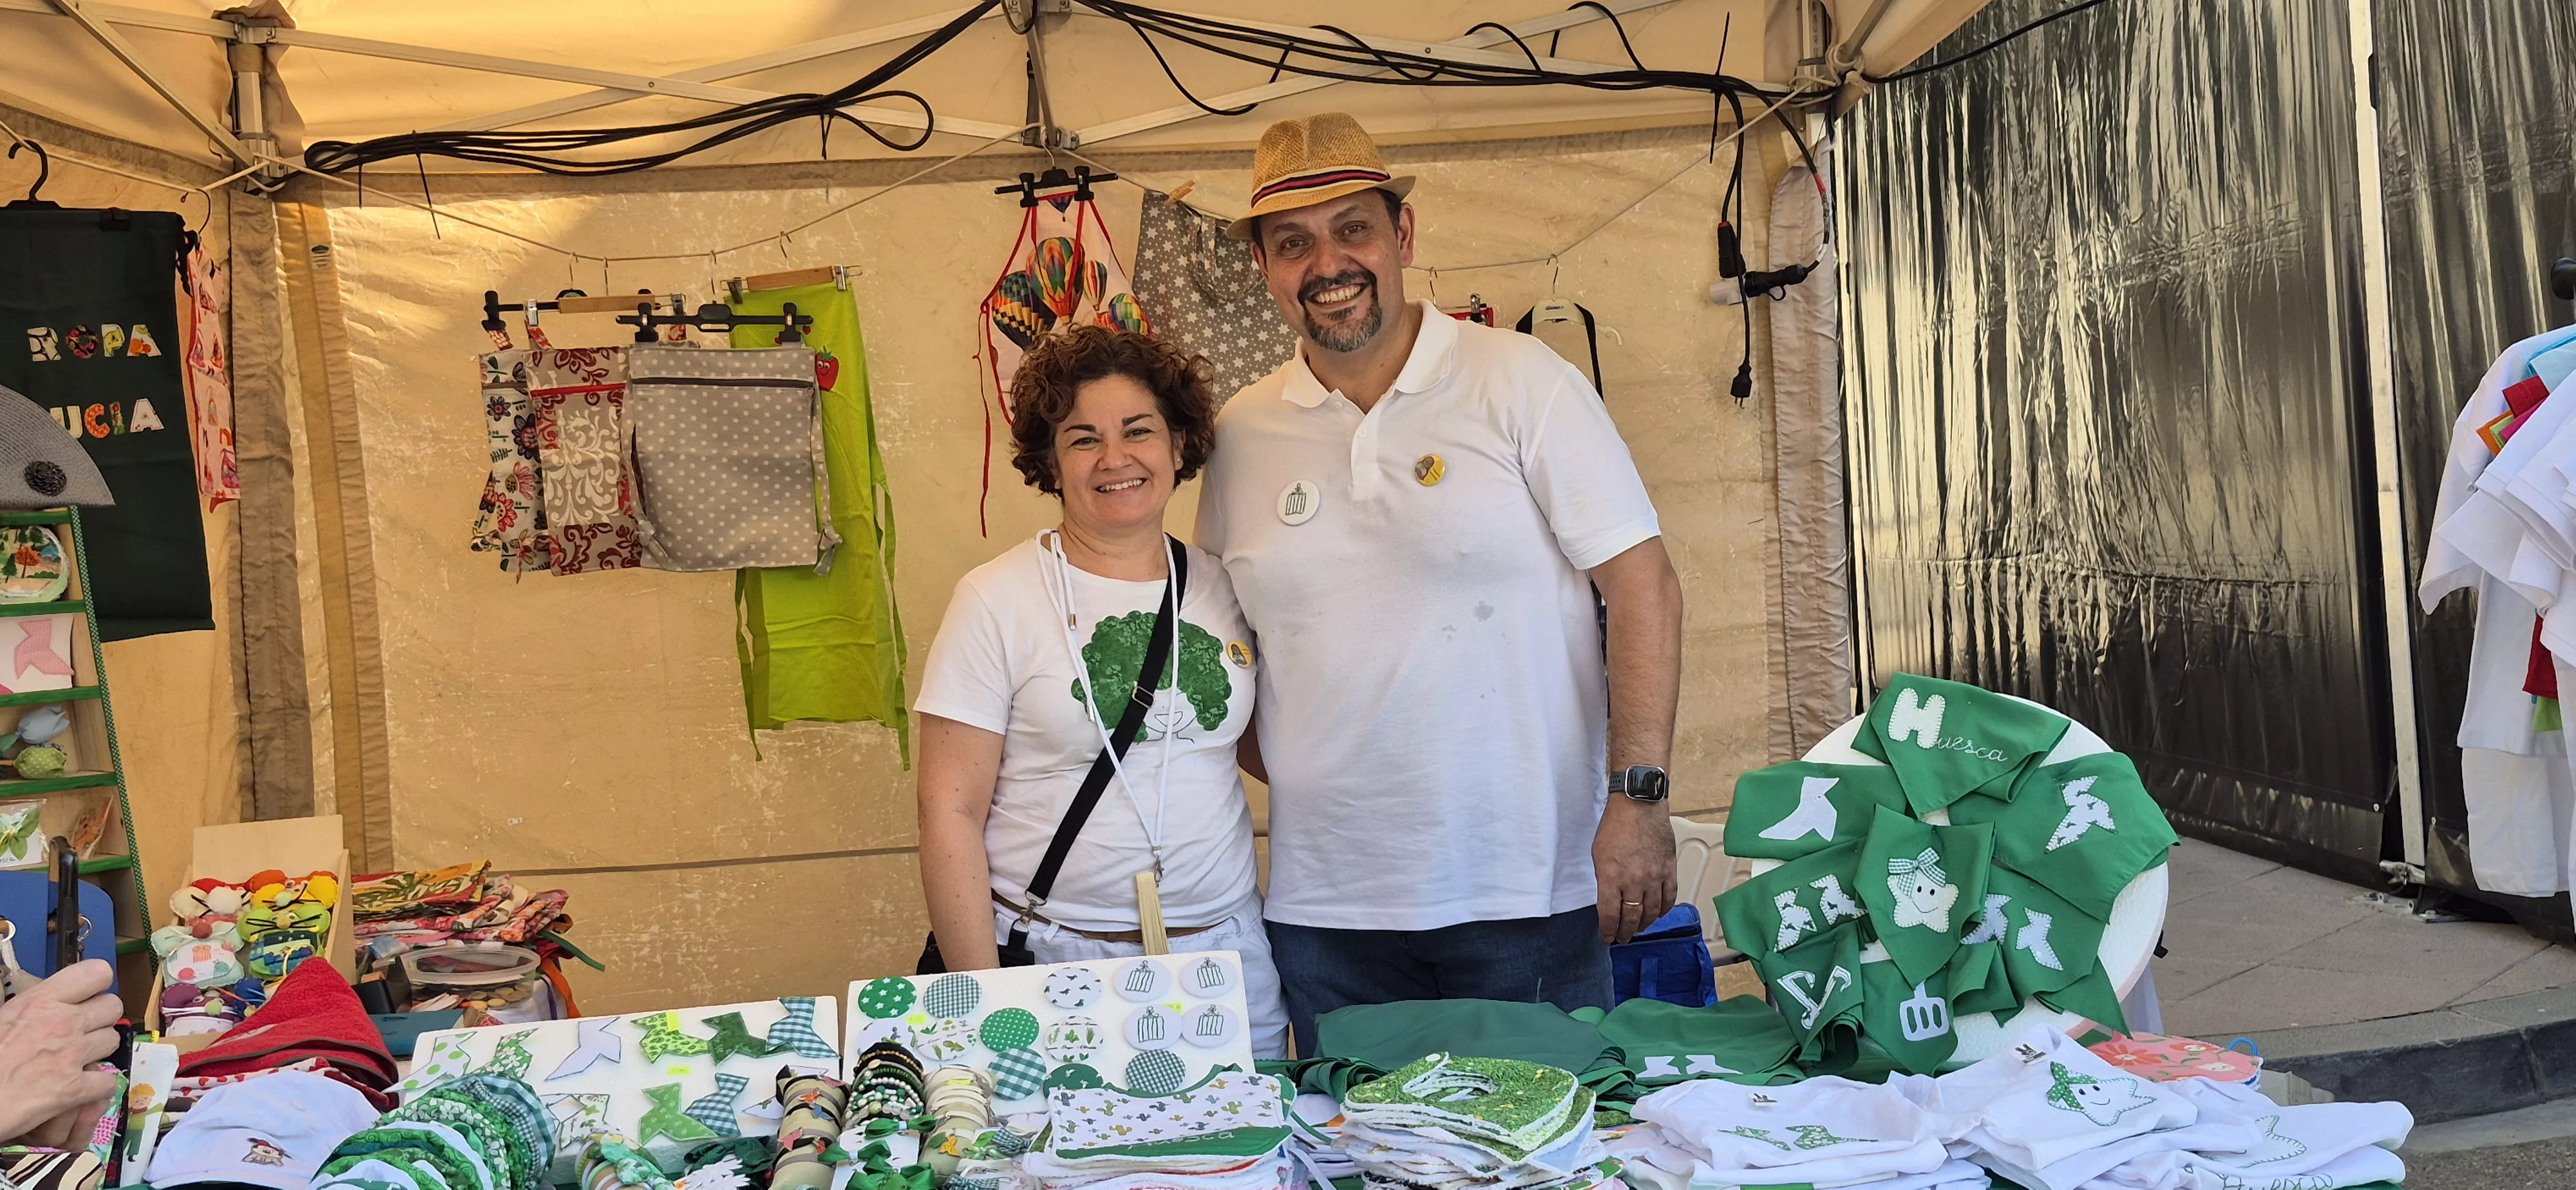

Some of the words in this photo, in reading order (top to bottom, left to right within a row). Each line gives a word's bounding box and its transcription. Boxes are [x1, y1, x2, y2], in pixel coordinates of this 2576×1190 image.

[26, 323, 163, 363] ROPA
[1888, 687, 2008, 762] Huesca
[1127, 1131, 1235, 1151] uesca
